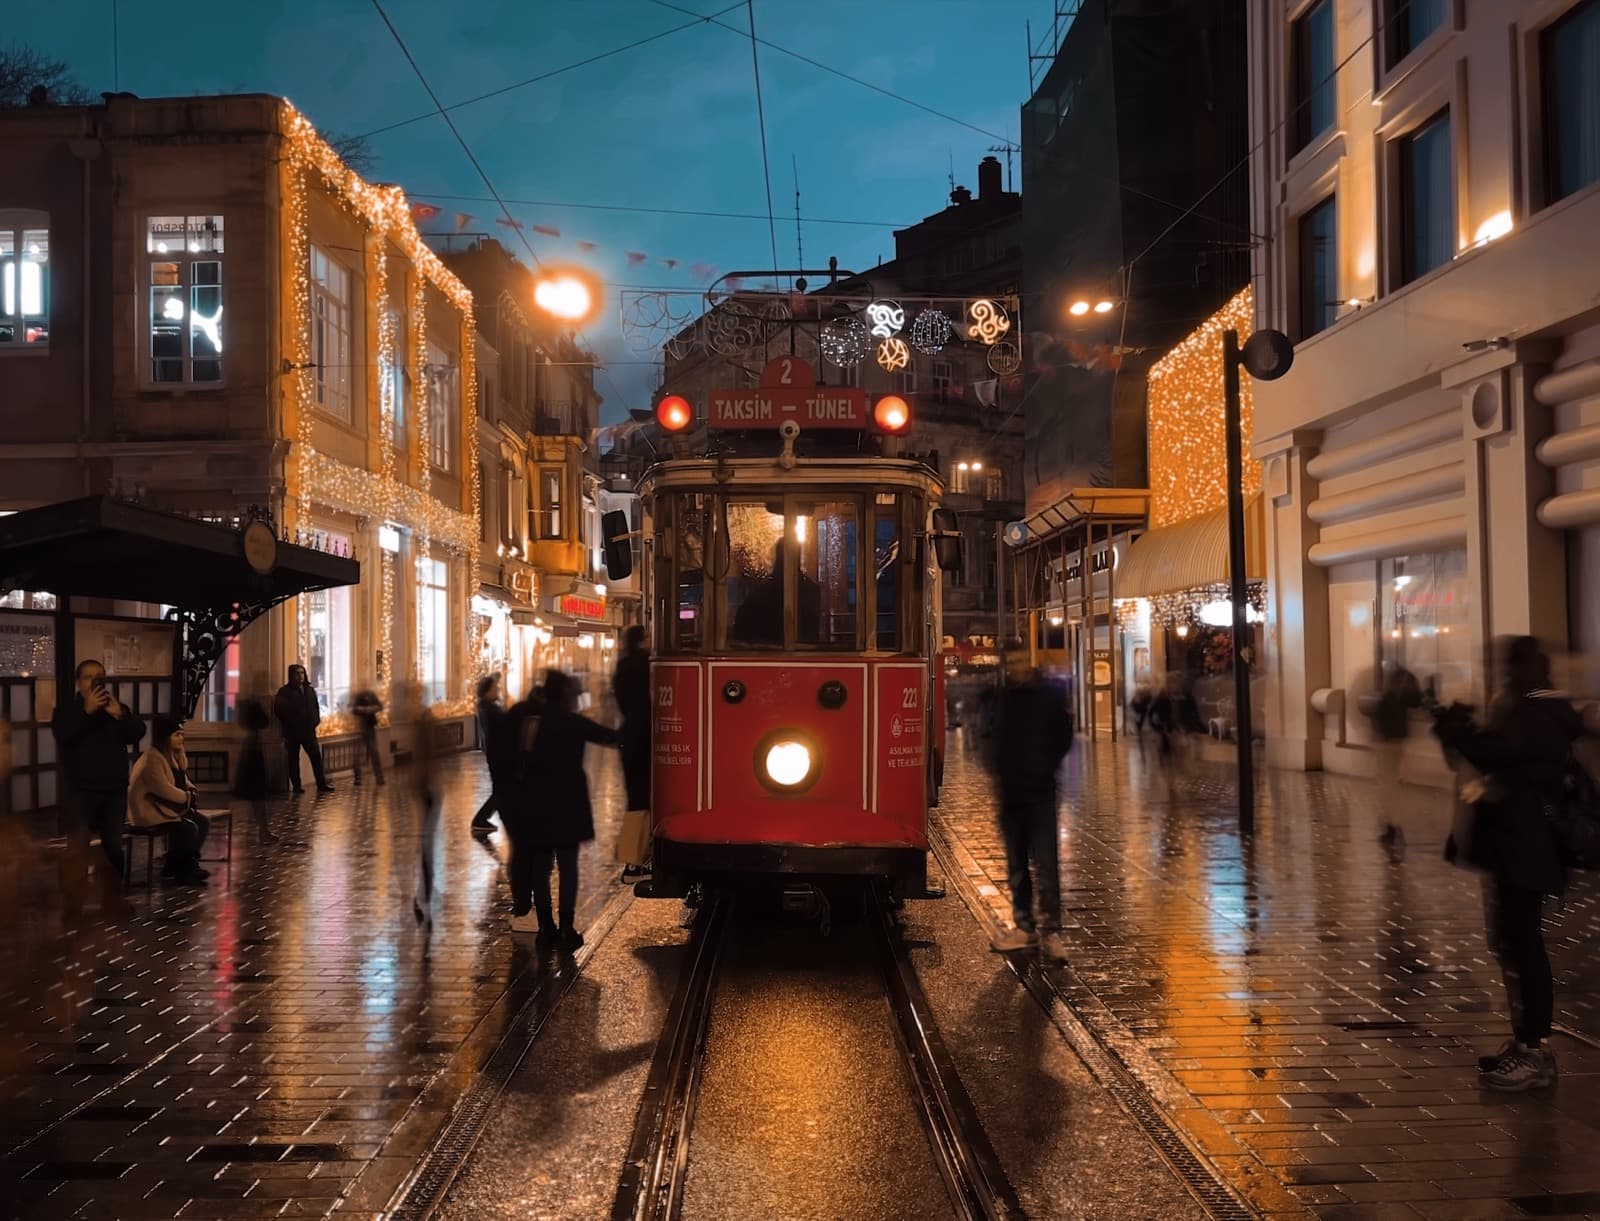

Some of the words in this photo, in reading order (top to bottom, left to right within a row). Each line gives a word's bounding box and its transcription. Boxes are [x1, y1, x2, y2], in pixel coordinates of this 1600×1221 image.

[780, 359, 792, 384] 2
[715, 394, 772, 419] TAKSİM
[805, 394, 856, 419] TÜNEL
[659, 686, 673, 706] 223
[903, 687, 918, 708] 223
